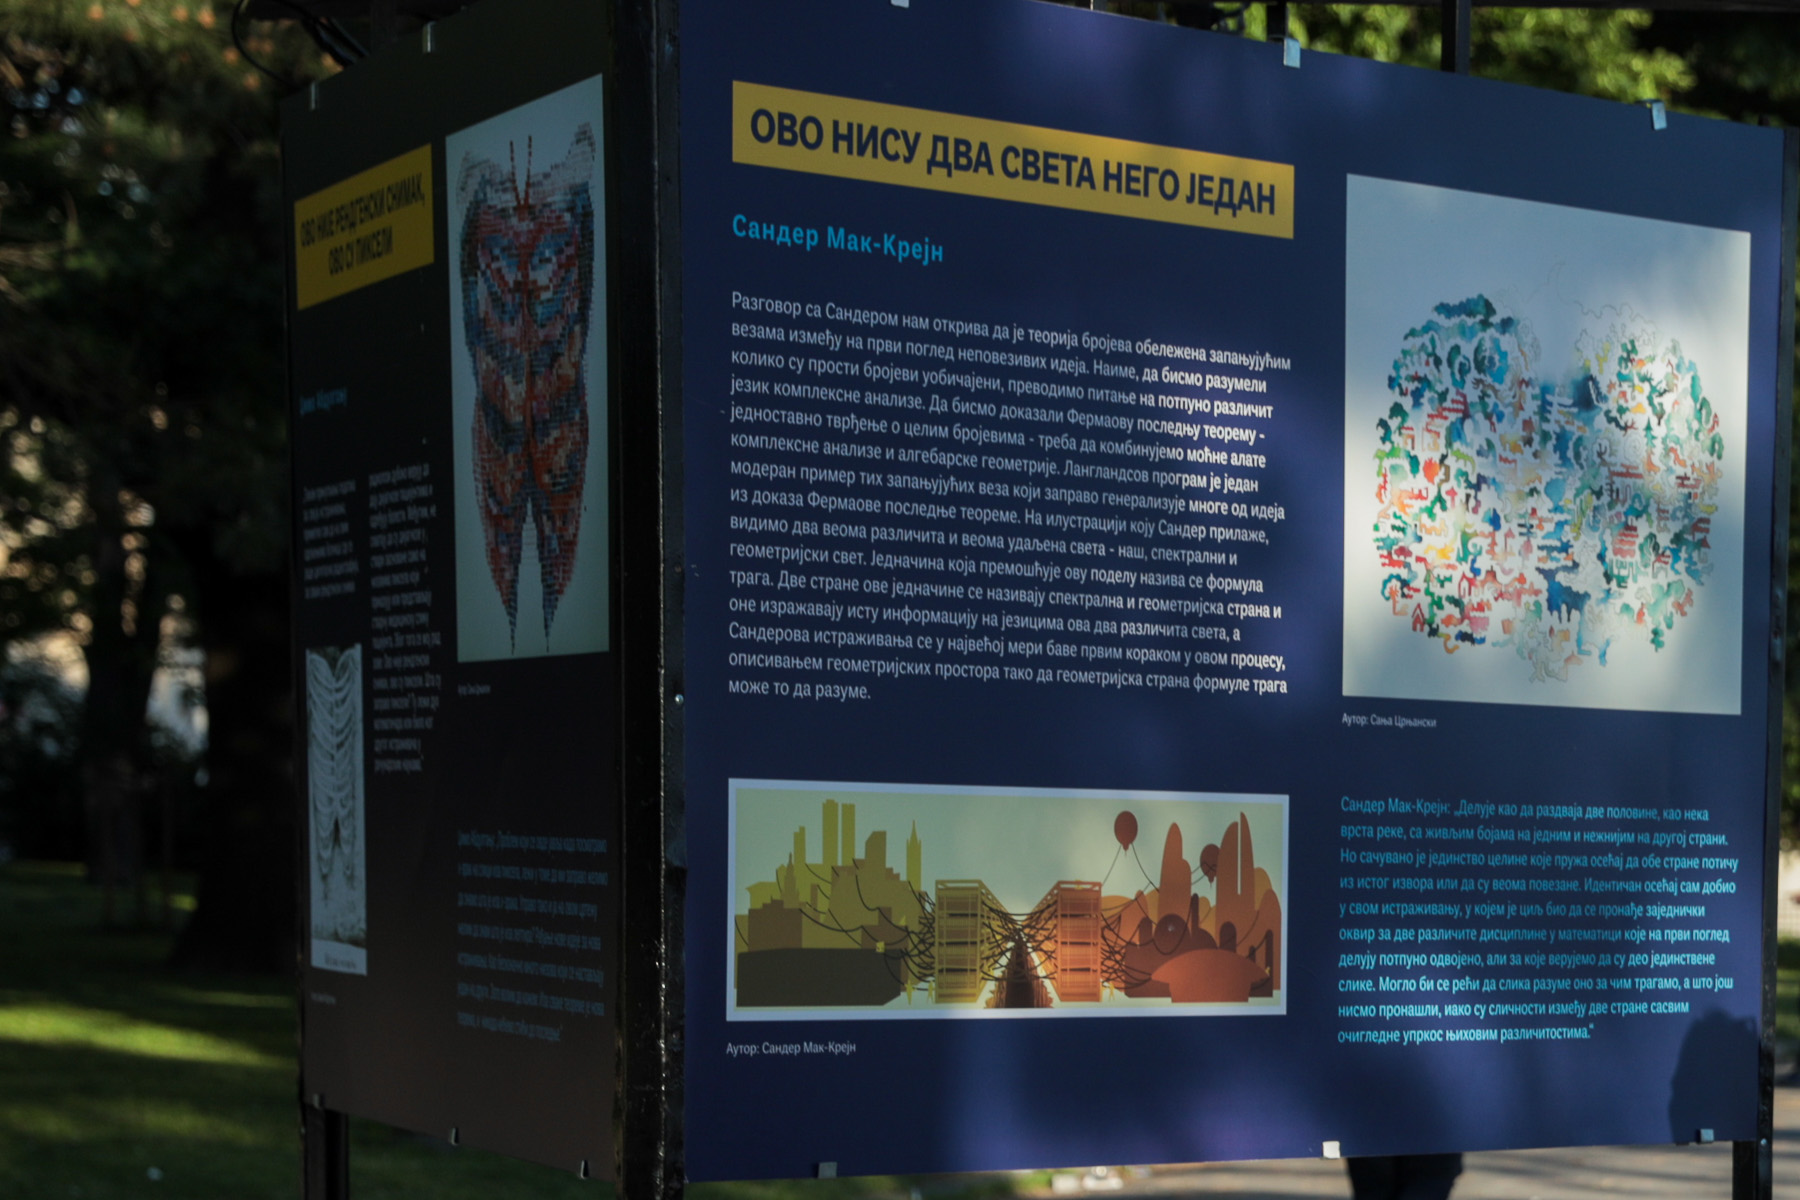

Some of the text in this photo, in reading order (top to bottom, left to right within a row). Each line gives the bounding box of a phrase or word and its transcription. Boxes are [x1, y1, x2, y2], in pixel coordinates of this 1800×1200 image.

[750, 107, 1275, 217] ОВО НИСУ ДВА СВЕТА НЕГО ЈЕДАН
[732, 213, 943, 266] Сандер Мак-Крејн
[732, 290, 1291, 372] Разговор са Сандером нам открива да је теорија бројева обележена запањујућим
[731, 322, 1266, 394] везама између на први поглед неповезивих идеја. Наиме, да бисмо разумели
[731, 350, 1274, 419] колико су прости бројеви уобичајени, преводимо питање на потпуно различит
[730, 433, 1258, 494] комплексне анализе и алгебарске геометрије. Лангландсов програм је један
[730, 488, 1269, 545] из доказа Фермаове последње теореме. На илустрацији коју Сандер прилаже,
[729, 542, 1264, 595] геометријски свет. Једначина која премошћује ову поделу назива се формула
[728, 652, 1288, 696] описивањем геометријских простора тако да геометријска страна формуле трага
[728, 679, 871, 702] може то да разуме.
[1340, 795, 1709, 821] Сандер Мак-Крејн: „Делује као да раздваја две половине, као нека
[1340, 825, 1728, 848] врста реке, са живљим бојама на једним и нежнијим на другој страни.
[1338, 928, 1730, 944] оквир за две различите дисциплине у математици које на први поглед
[1338, 950, 1716, 970] делују потпуно одвојено, али за које верујемо да су део јединствене
[1338, 999, 1690, 1020] нисмо пронашли, иако су сличности између две стране сасвим
[726, 1041, 856, 1057] Аутор: Сандер Мак-Крејн
[1337, 1030, 1401, 1044] очигледне
[1402, 1029, 1444, 1046] упркос
[1445, 1028, 1498, 1041] њиховим
